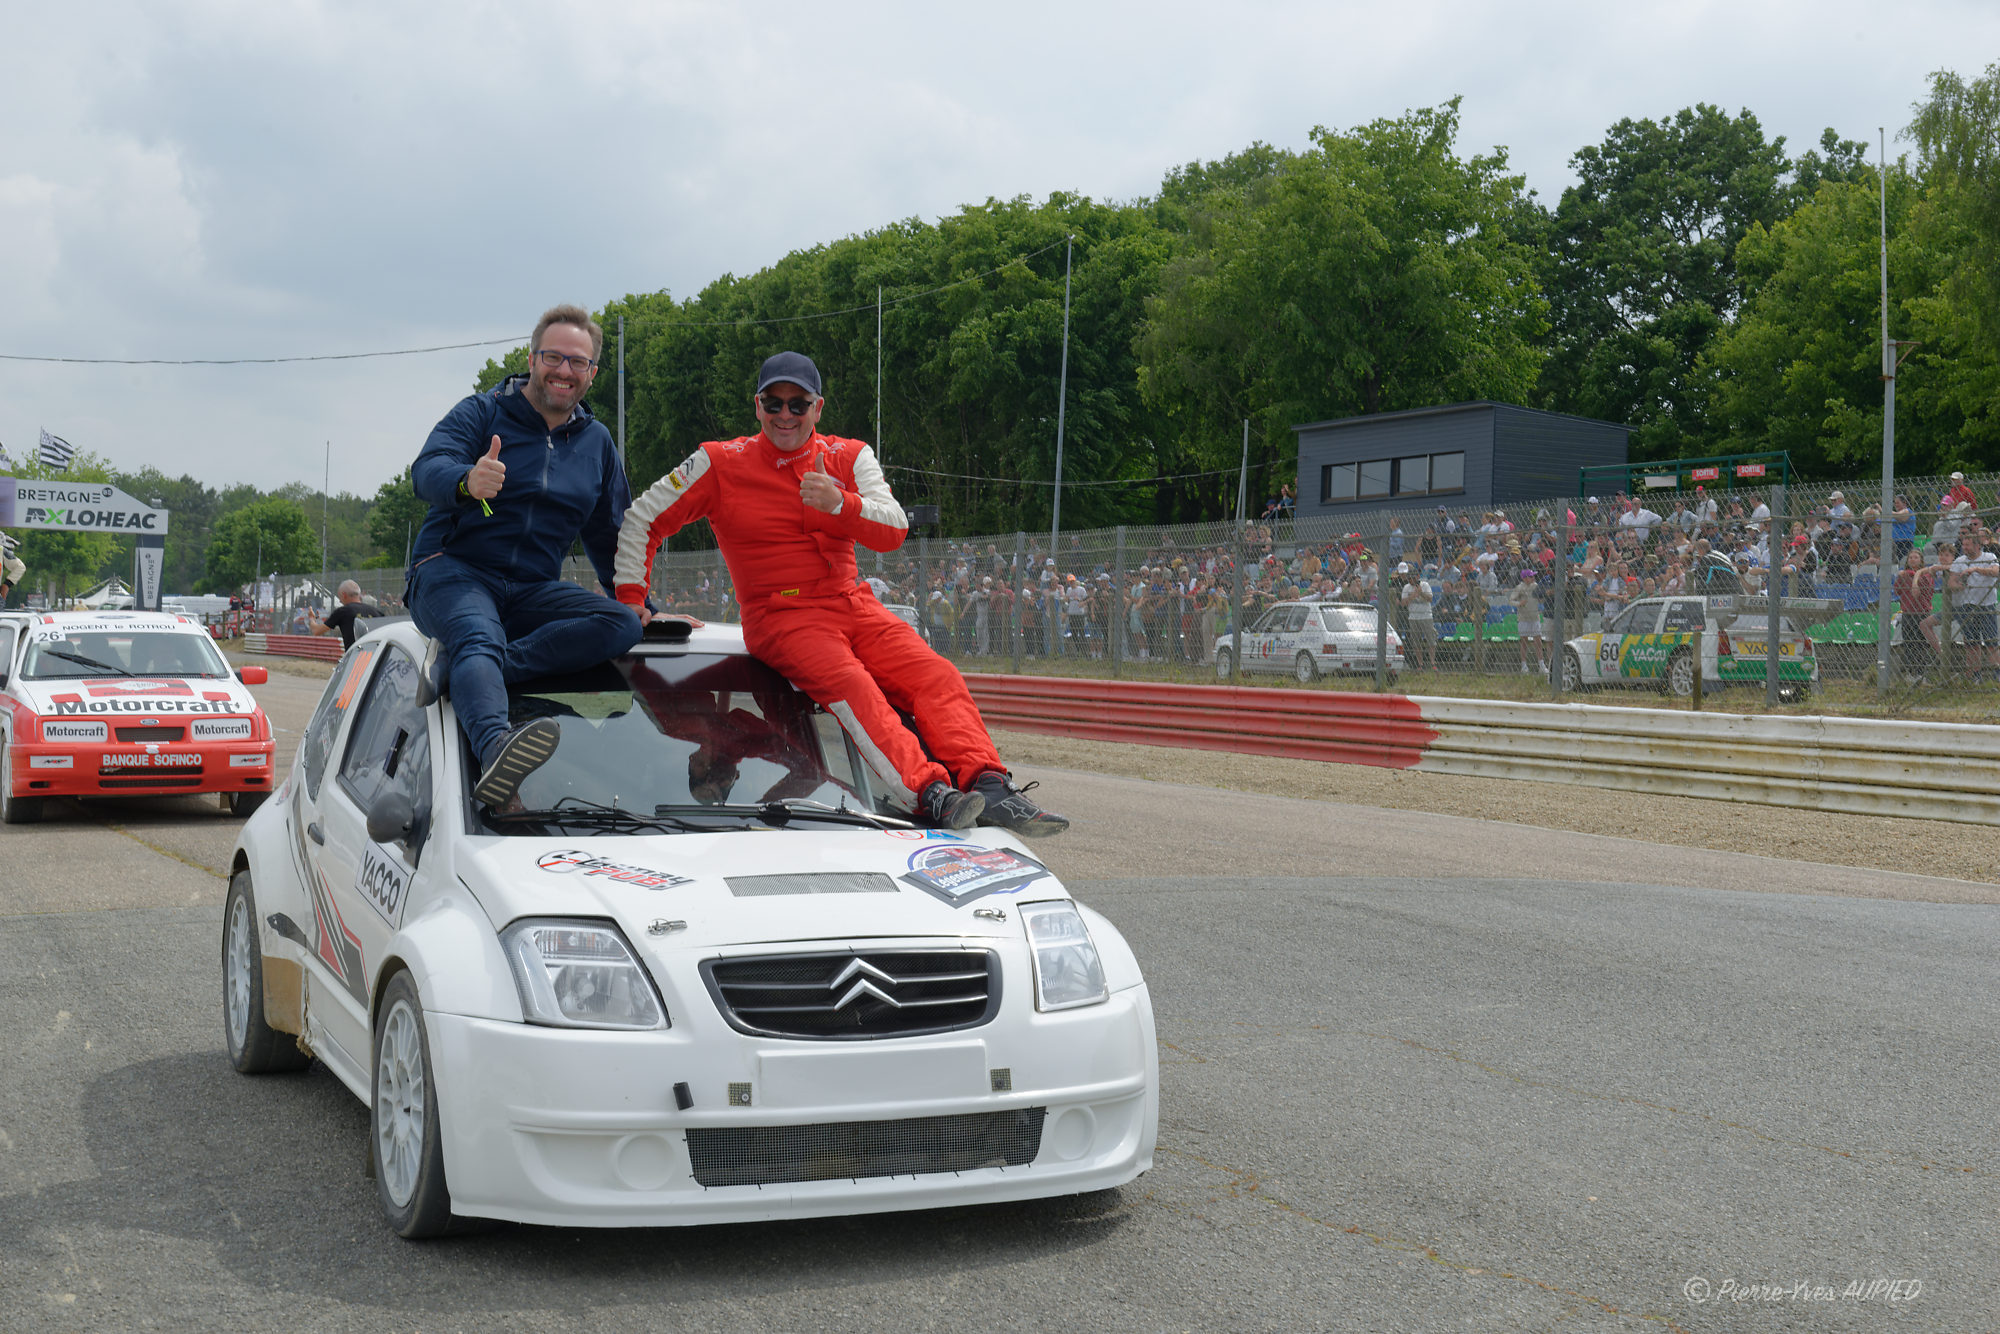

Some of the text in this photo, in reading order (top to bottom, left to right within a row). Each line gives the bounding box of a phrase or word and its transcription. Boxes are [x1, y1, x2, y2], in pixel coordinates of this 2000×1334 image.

[1696, 468, 1714, 477] SORTIE
[1741, 466, 1760, 474] SORTIE
[18, 488, 100, 504] BRETAGNE
[147, 559, 155, 600] BRETAGNE
[39, 631, 60, 642] 26
[1600, 642, 1619, 661] 60
[1745, 643, 1789, 655] YACO
[55, 699, 236, 715] Motorcraft
[46, 726, 104, 738] Motorcraft
[195, 723, 249, 735] Motorcraft
[103, 753, 202, 767] BANQUE SOFINCO
[361, 850, 401, 915] YACCO
